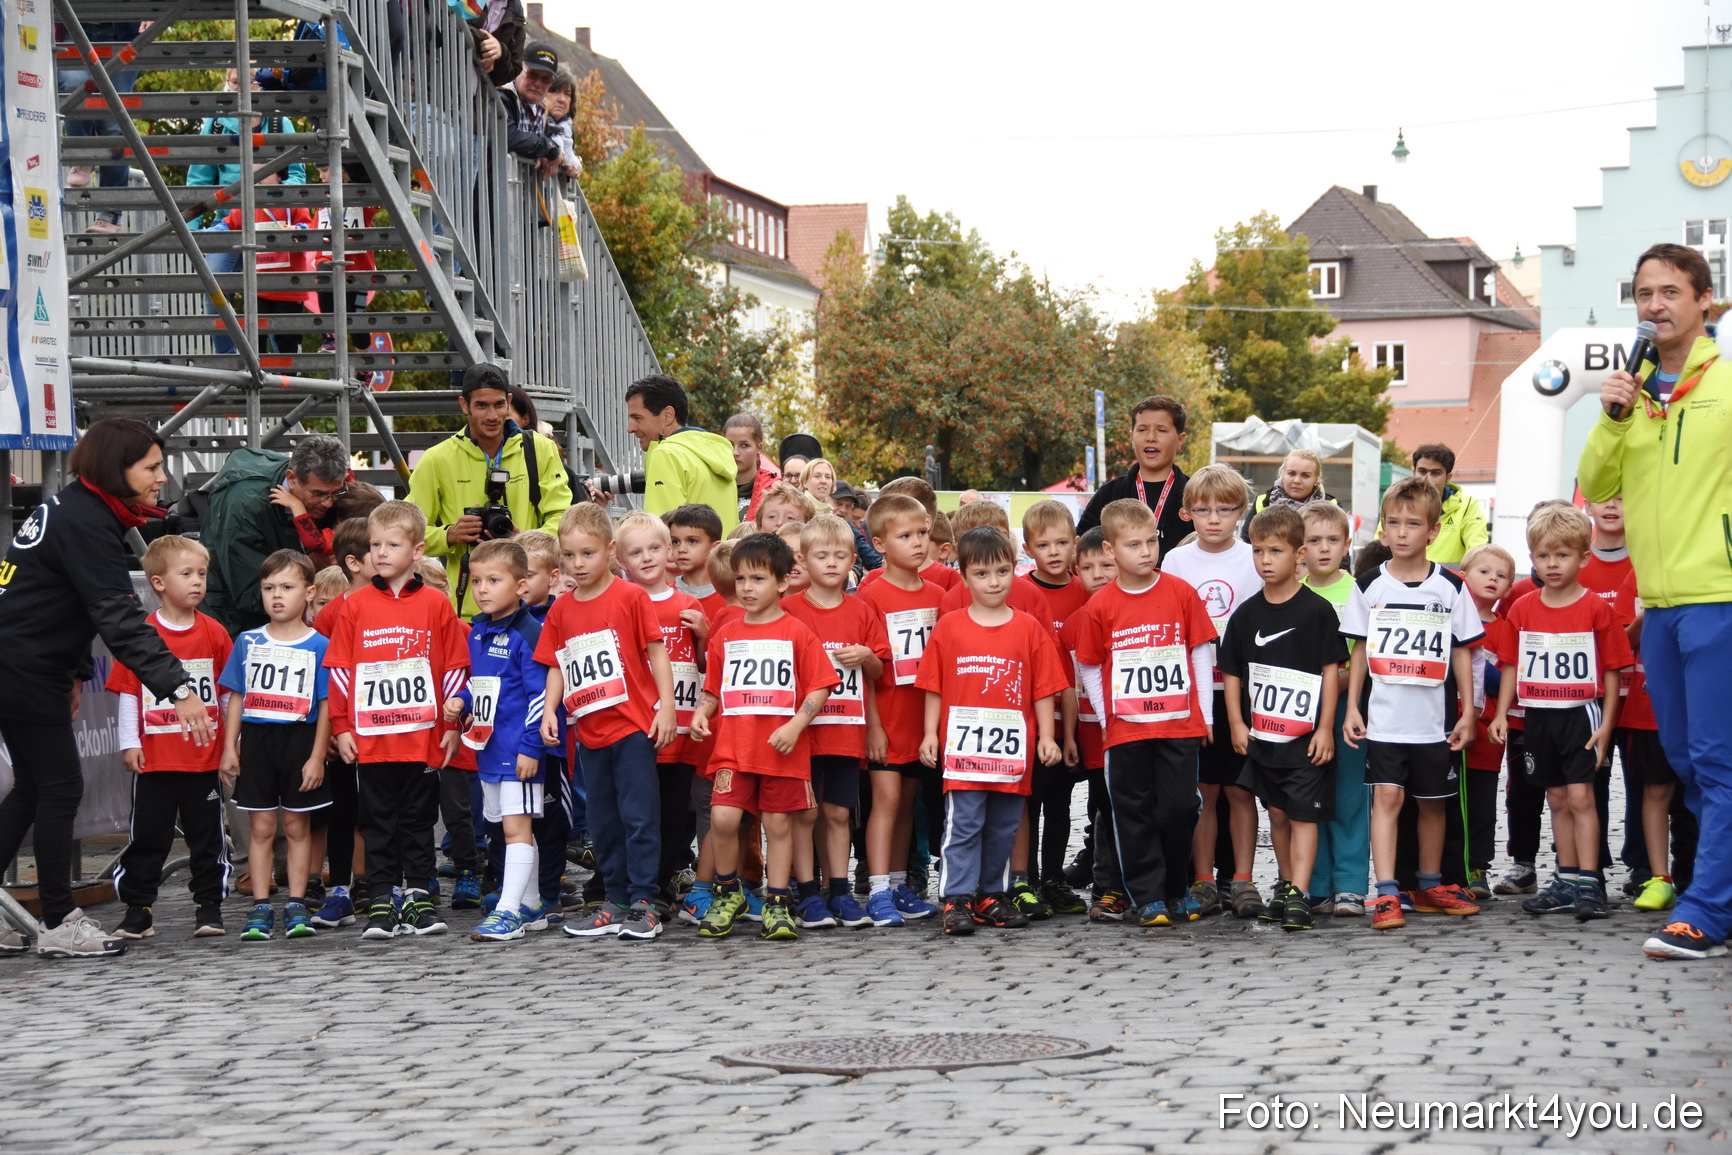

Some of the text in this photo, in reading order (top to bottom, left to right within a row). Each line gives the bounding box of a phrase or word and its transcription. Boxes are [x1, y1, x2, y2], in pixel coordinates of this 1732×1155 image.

[27, 253, 42, 268] swn
[1584, 343, 1629, 371] BM
[920, 610, 938, 620] BOC
[1405, 611, 1445, 624] BOCK
[363, 625, 414, 637] Neumarkter
[363, 635, 405, 648] Stadtlauf
[1377, 627, 1443, 658] 7244
[1548, 635, 1587, 646] BOCK
[754, 642, 792, 653] BOCK
[1145, 647, 1181, 660] BOCK
[273, 648, 308, 661] BOCK
[956, 655, 1006, 665] Neumarkter
[183, 661, 210, 670] OCK
[386, 660, 425, 672] BOCK
[565, 650, 614, 692] 7046
[729, 658, 792, 686] 7206
[956, 665, 996, 676] Stadtlauf
[1389, 662, 1427, 675] Patrick
[1526, 651, 1589, 680] 7180
[251, 663, 306, 693] 7011
[1120, 664, 1185, 694] 7094
[1275, 670, 1314, 685] BOCK
[363, 676, 428, 706] 7008
[571, 686, 607, 708] Leopold
[1526, 685, 1585, 698] Maximilian
[250, 695, 295, 711] Johannes
[742, 693, 773, 705] Timur
[1143, 700, 1165, 711] Max
[1253, 682, 1312, 717] 7079
[372, 711, 422, 724] Benjamin
[983, 710, 1020, 722] BOCK
[1261, 718, 1286, 733] Vitus
[956, 725, 1020, 755] 7125
[955, 758, 1015, 773] Maximilian
